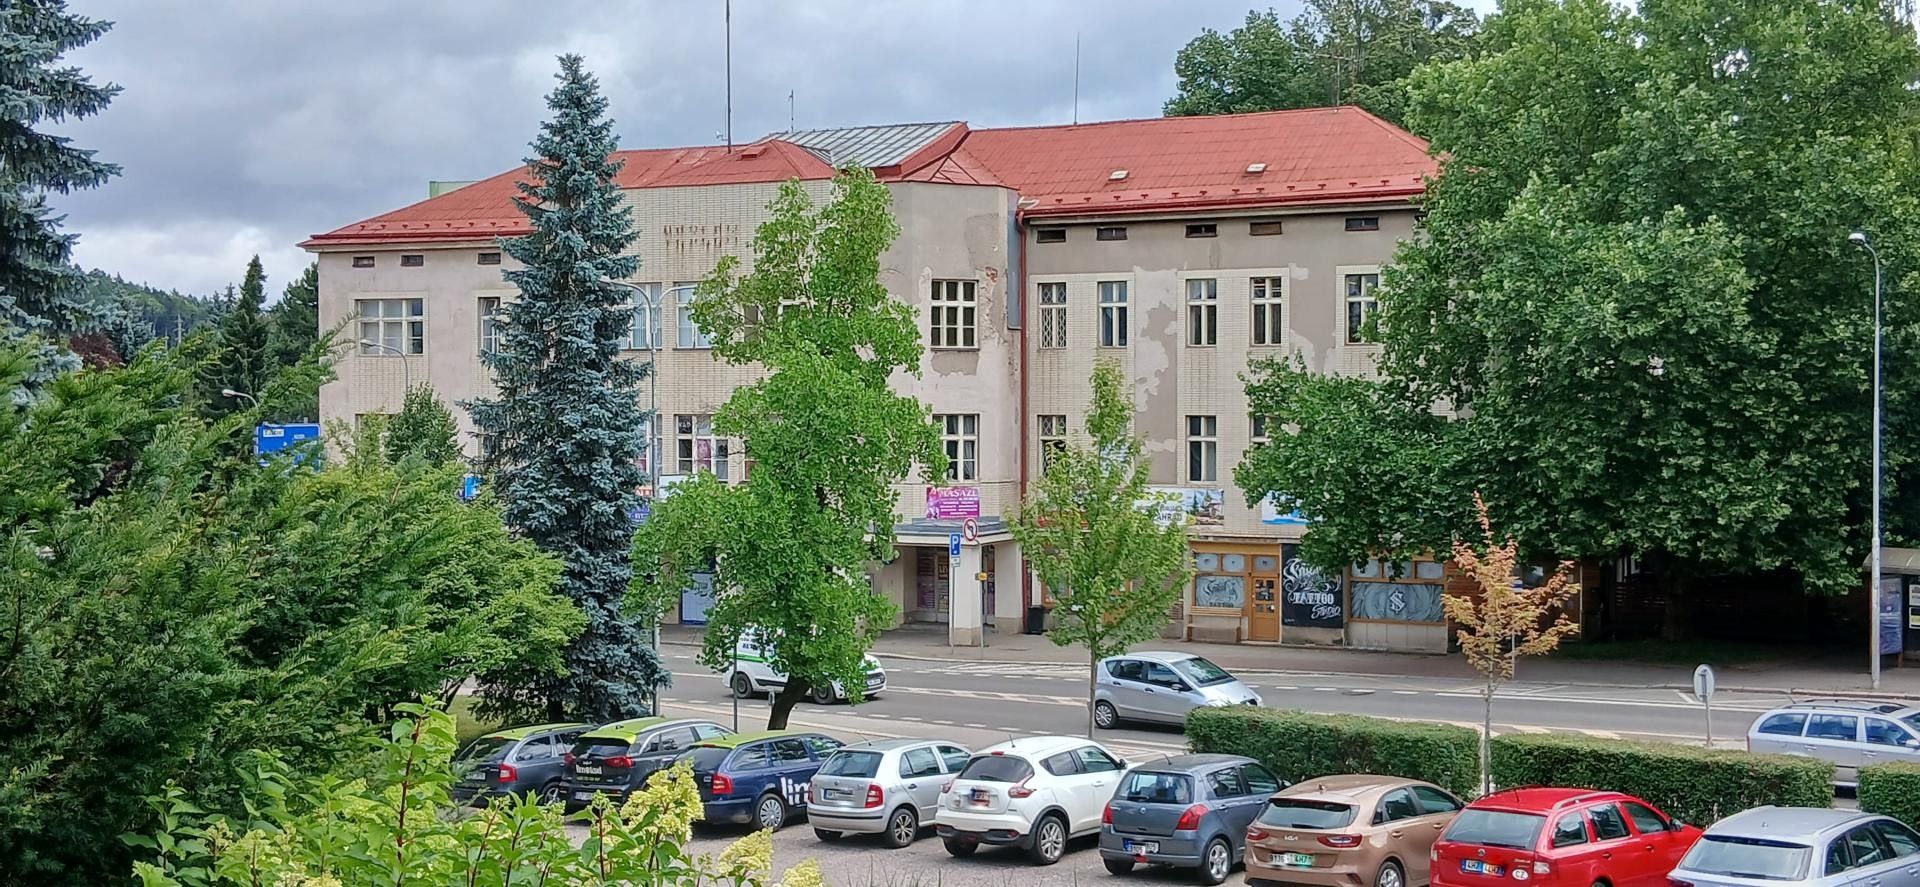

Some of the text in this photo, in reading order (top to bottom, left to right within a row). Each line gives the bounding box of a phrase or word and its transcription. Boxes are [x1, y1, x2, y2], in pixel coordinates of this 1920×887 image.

[952, 536, 959, 549] P
[1292, 592, 1334, 605] TATTOO
[780, 776, 810, 806] lim
[1515, 870, 1526, 879] CZ
